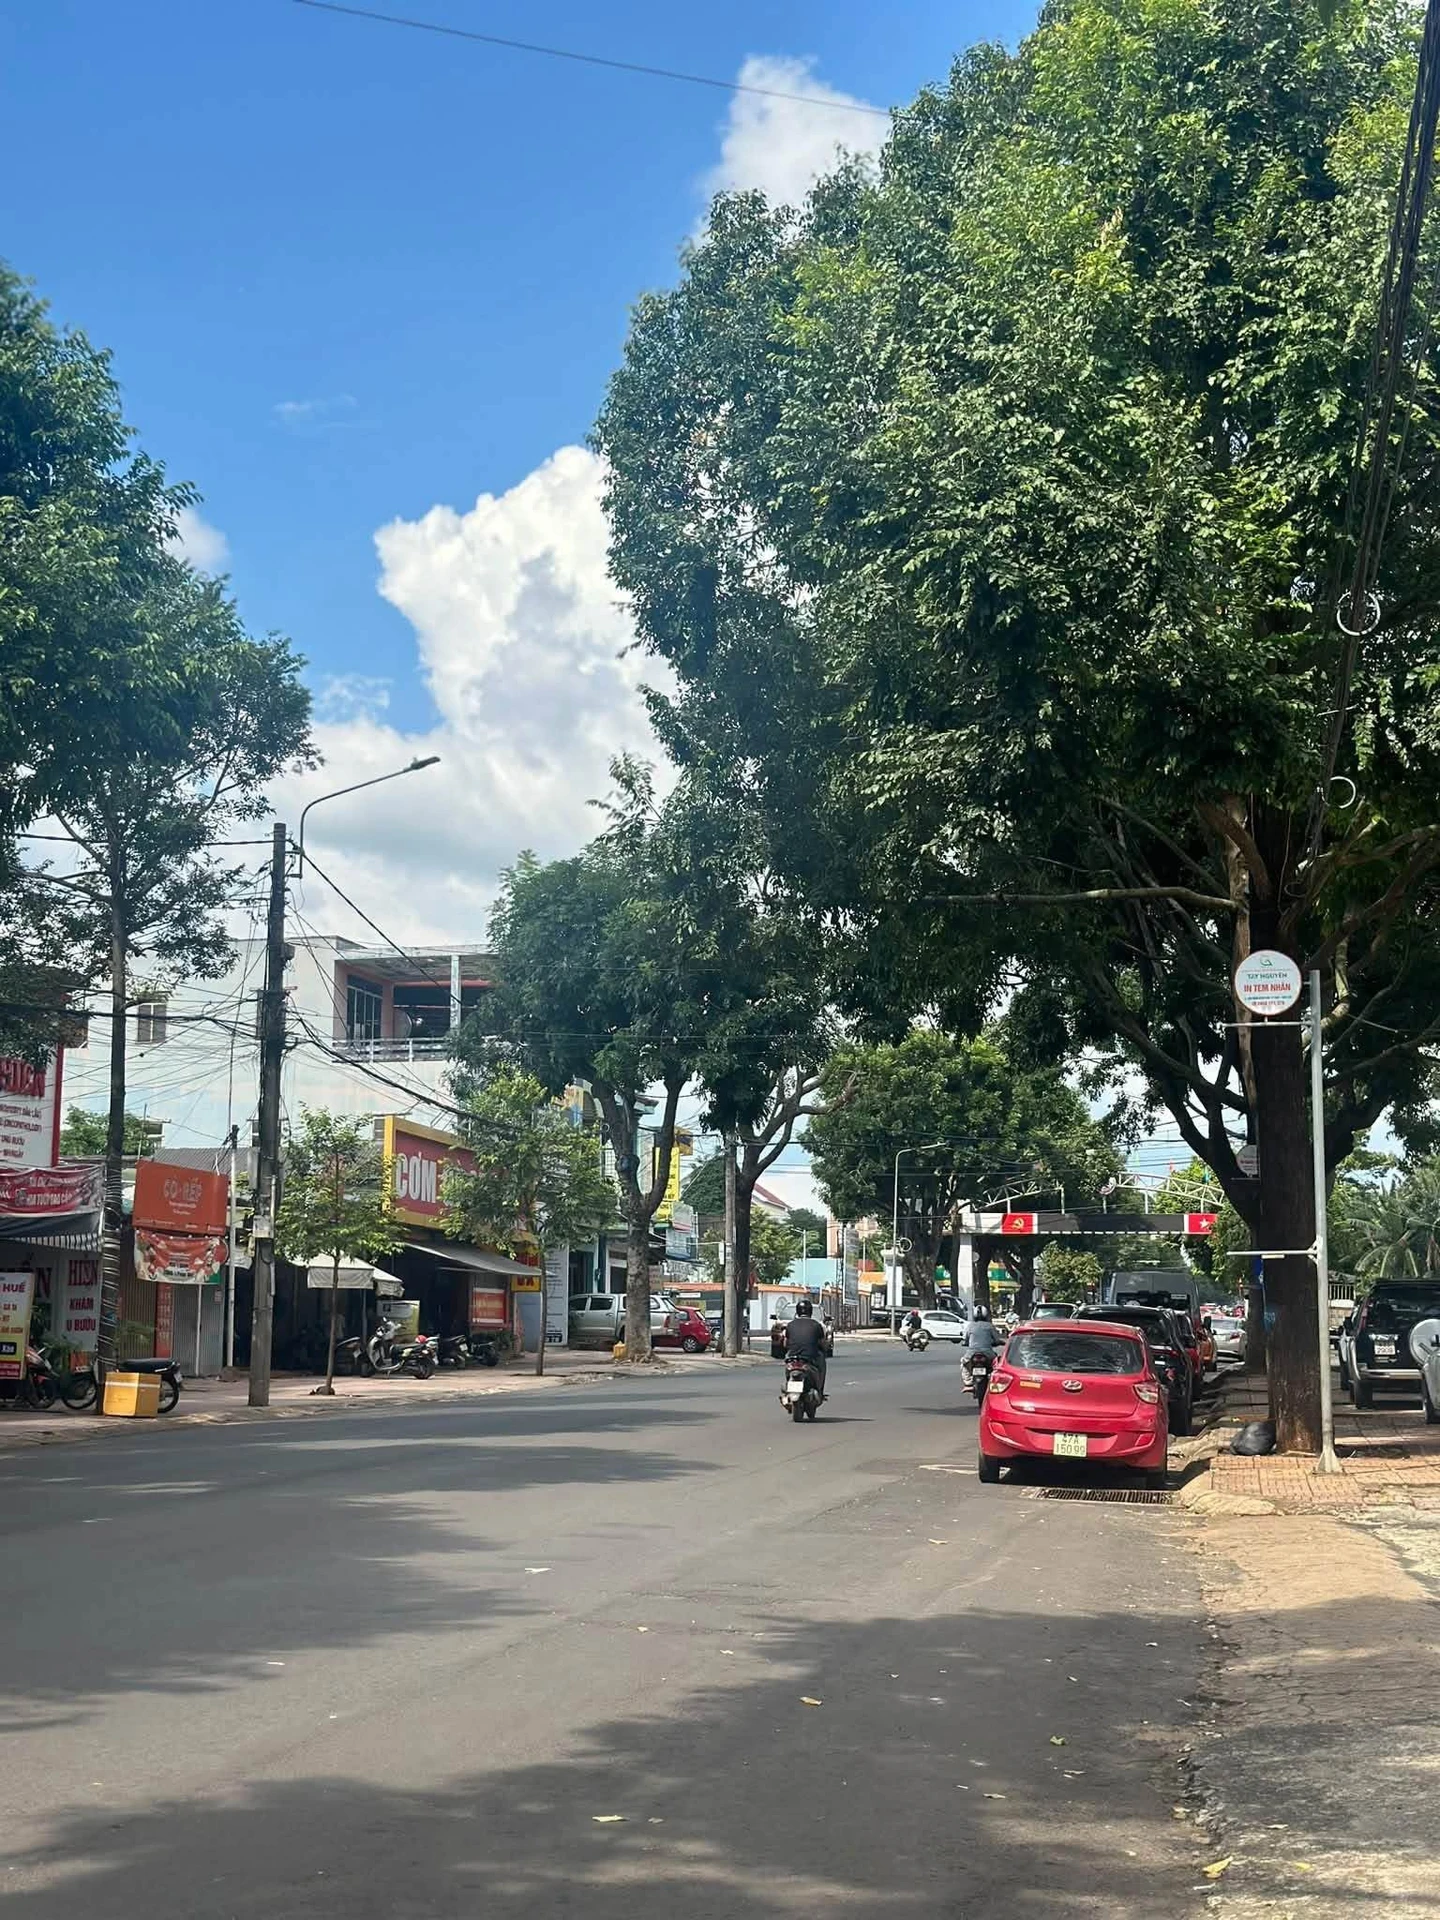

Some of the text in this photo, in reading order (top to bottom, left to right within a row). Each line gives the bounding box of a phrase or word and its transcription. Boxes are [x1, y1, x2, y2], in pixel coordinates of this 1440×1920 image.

[1244, 984, 1252, 993] IN
[1253, 984, 1270, 993] TEM
[396, 1151, 437, 1204] CƠM
